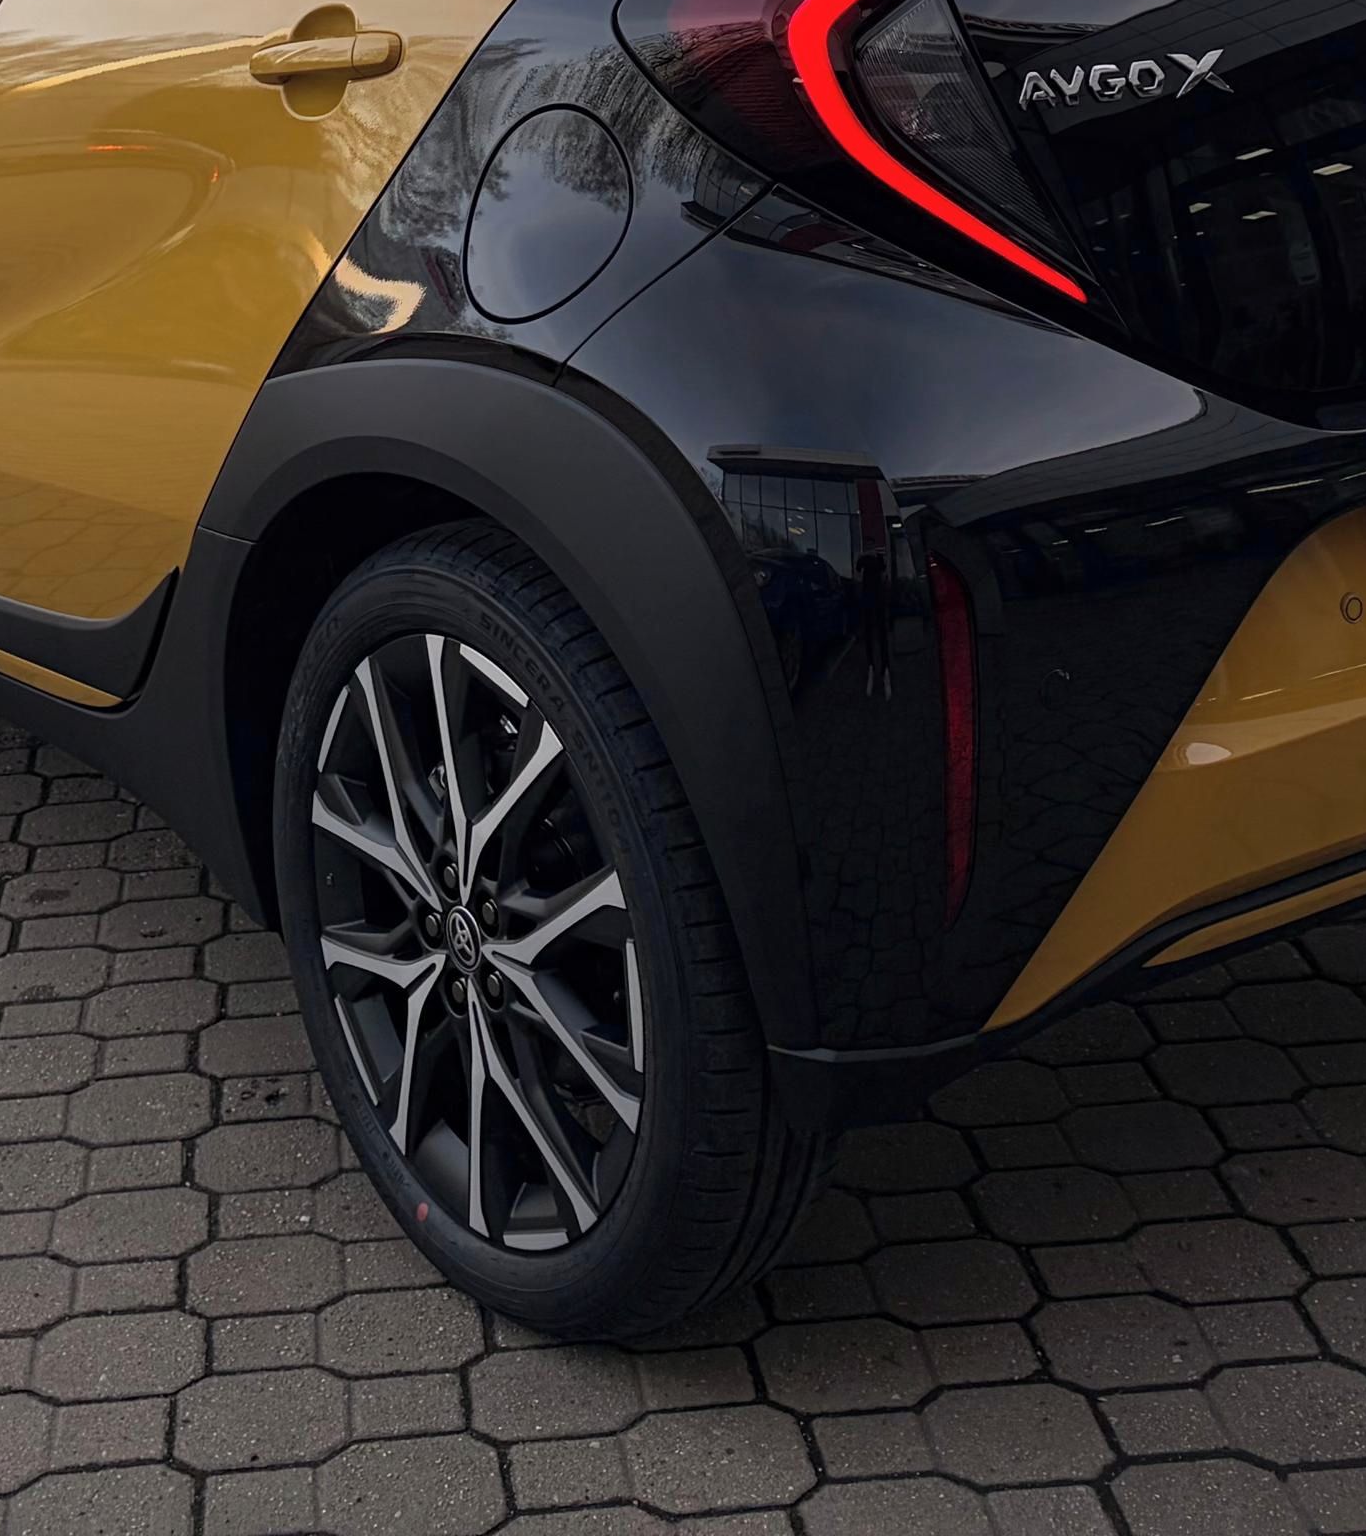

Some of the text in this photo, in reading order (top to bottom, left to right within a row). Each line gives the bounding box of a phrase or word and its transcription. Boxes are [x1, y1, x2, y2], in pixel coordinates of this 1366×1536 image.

[1019, 49, 1234, 111] AYGO X
[480, 613, 566, 713] SINCERA
